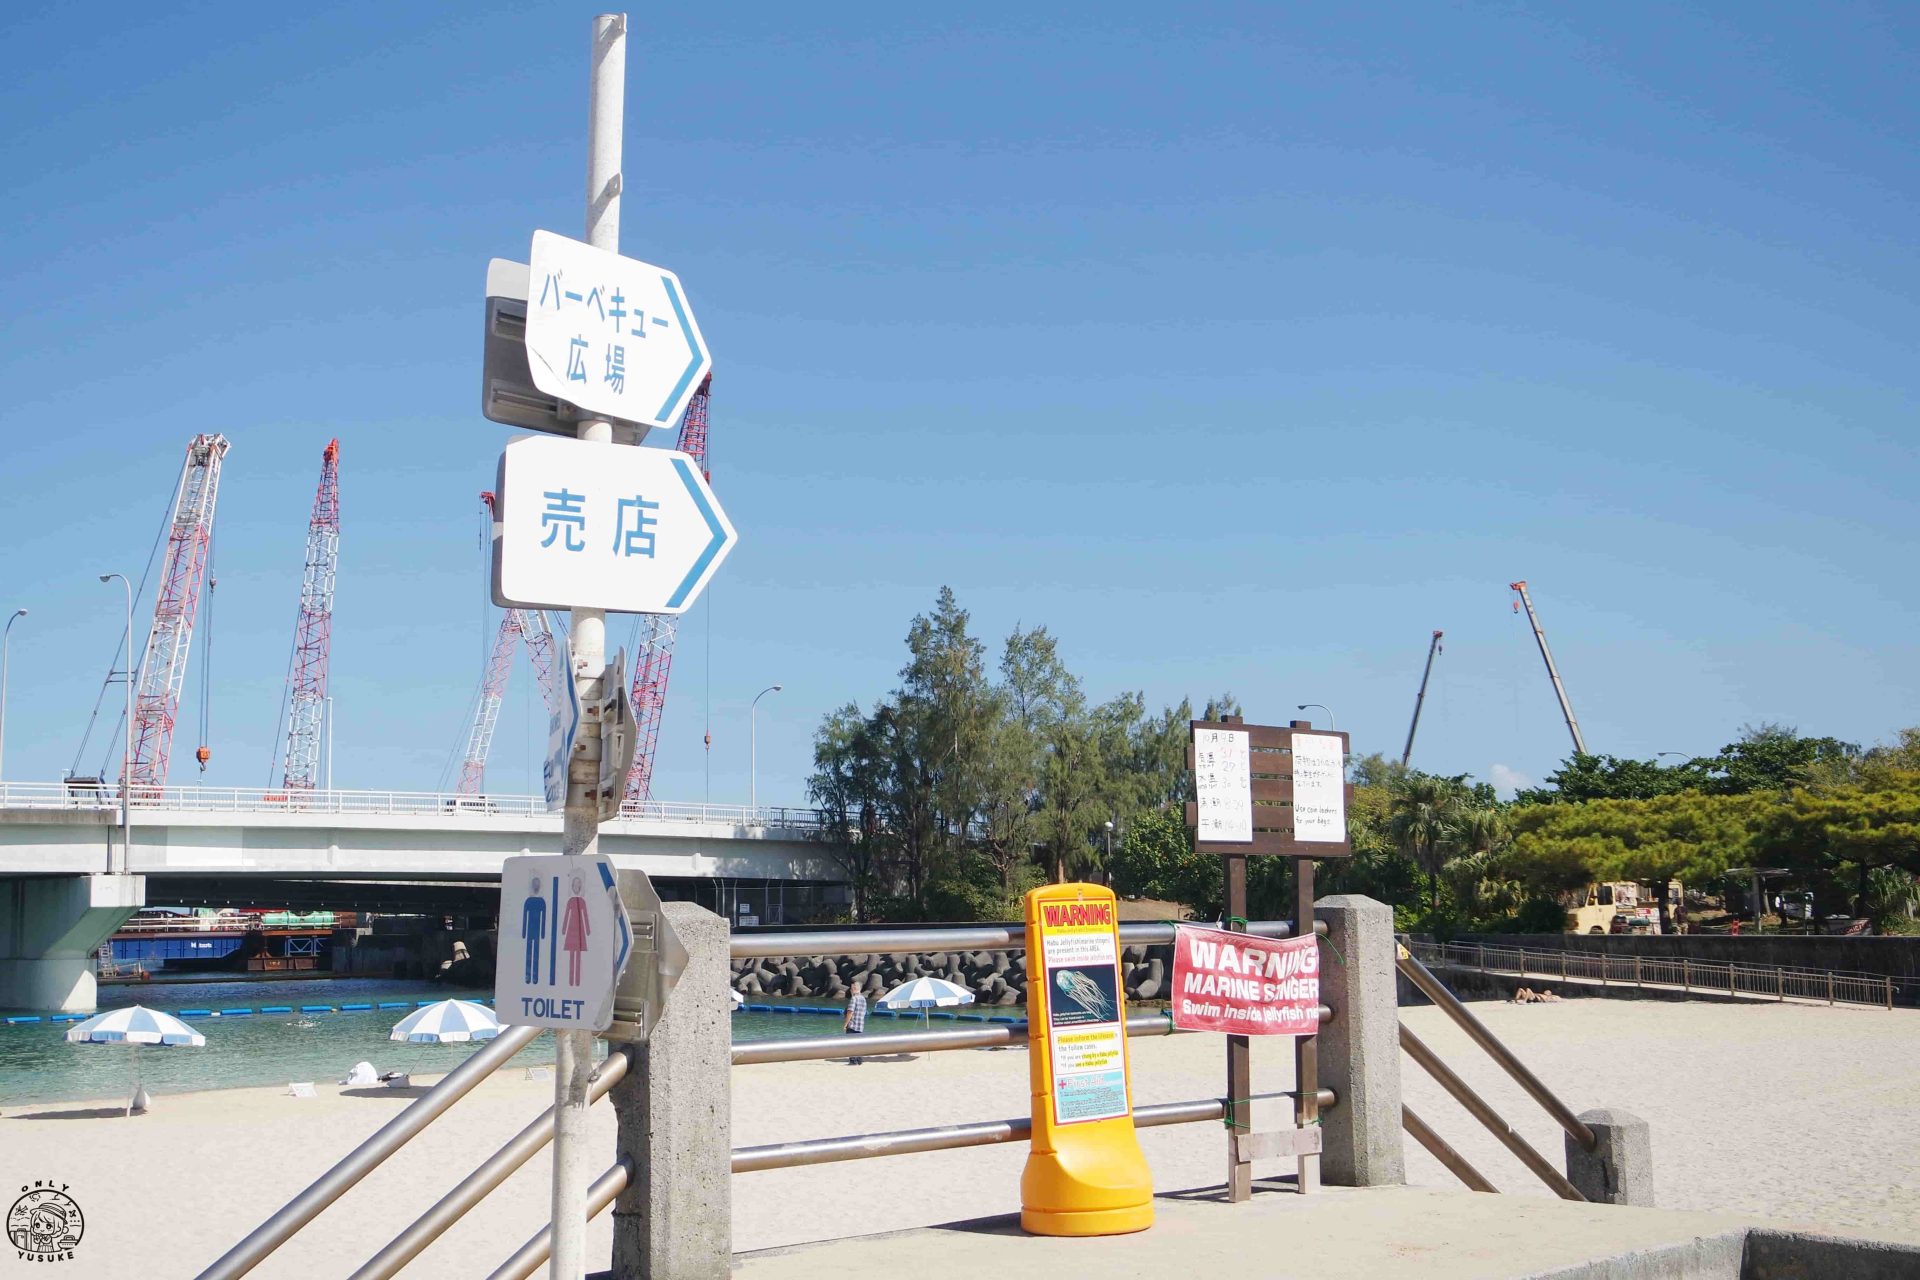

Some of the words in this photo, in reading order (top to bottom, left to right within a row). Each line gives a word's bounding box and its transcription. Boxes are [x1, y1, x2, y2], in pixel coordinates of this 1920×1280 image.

[540, 269, 668, 339] バーベキュー
[567, 333, 625, 396] 広場
[540, 488, 660, 560] 売店
[1043, 903, 1111, 927] WARNING
[1057, 947, 1074, 955] present
[1190, 938, 1318, 979] WARNING
[1184, 972, 1260, 1001] MARINE
[521, 997, 585, 1020] TOILET
[1182, 999, 1220, 1017] Swim
[1224, 1001, 1262, 1021] inside
[1262, 1005, 1304, 1023] jellyfish
